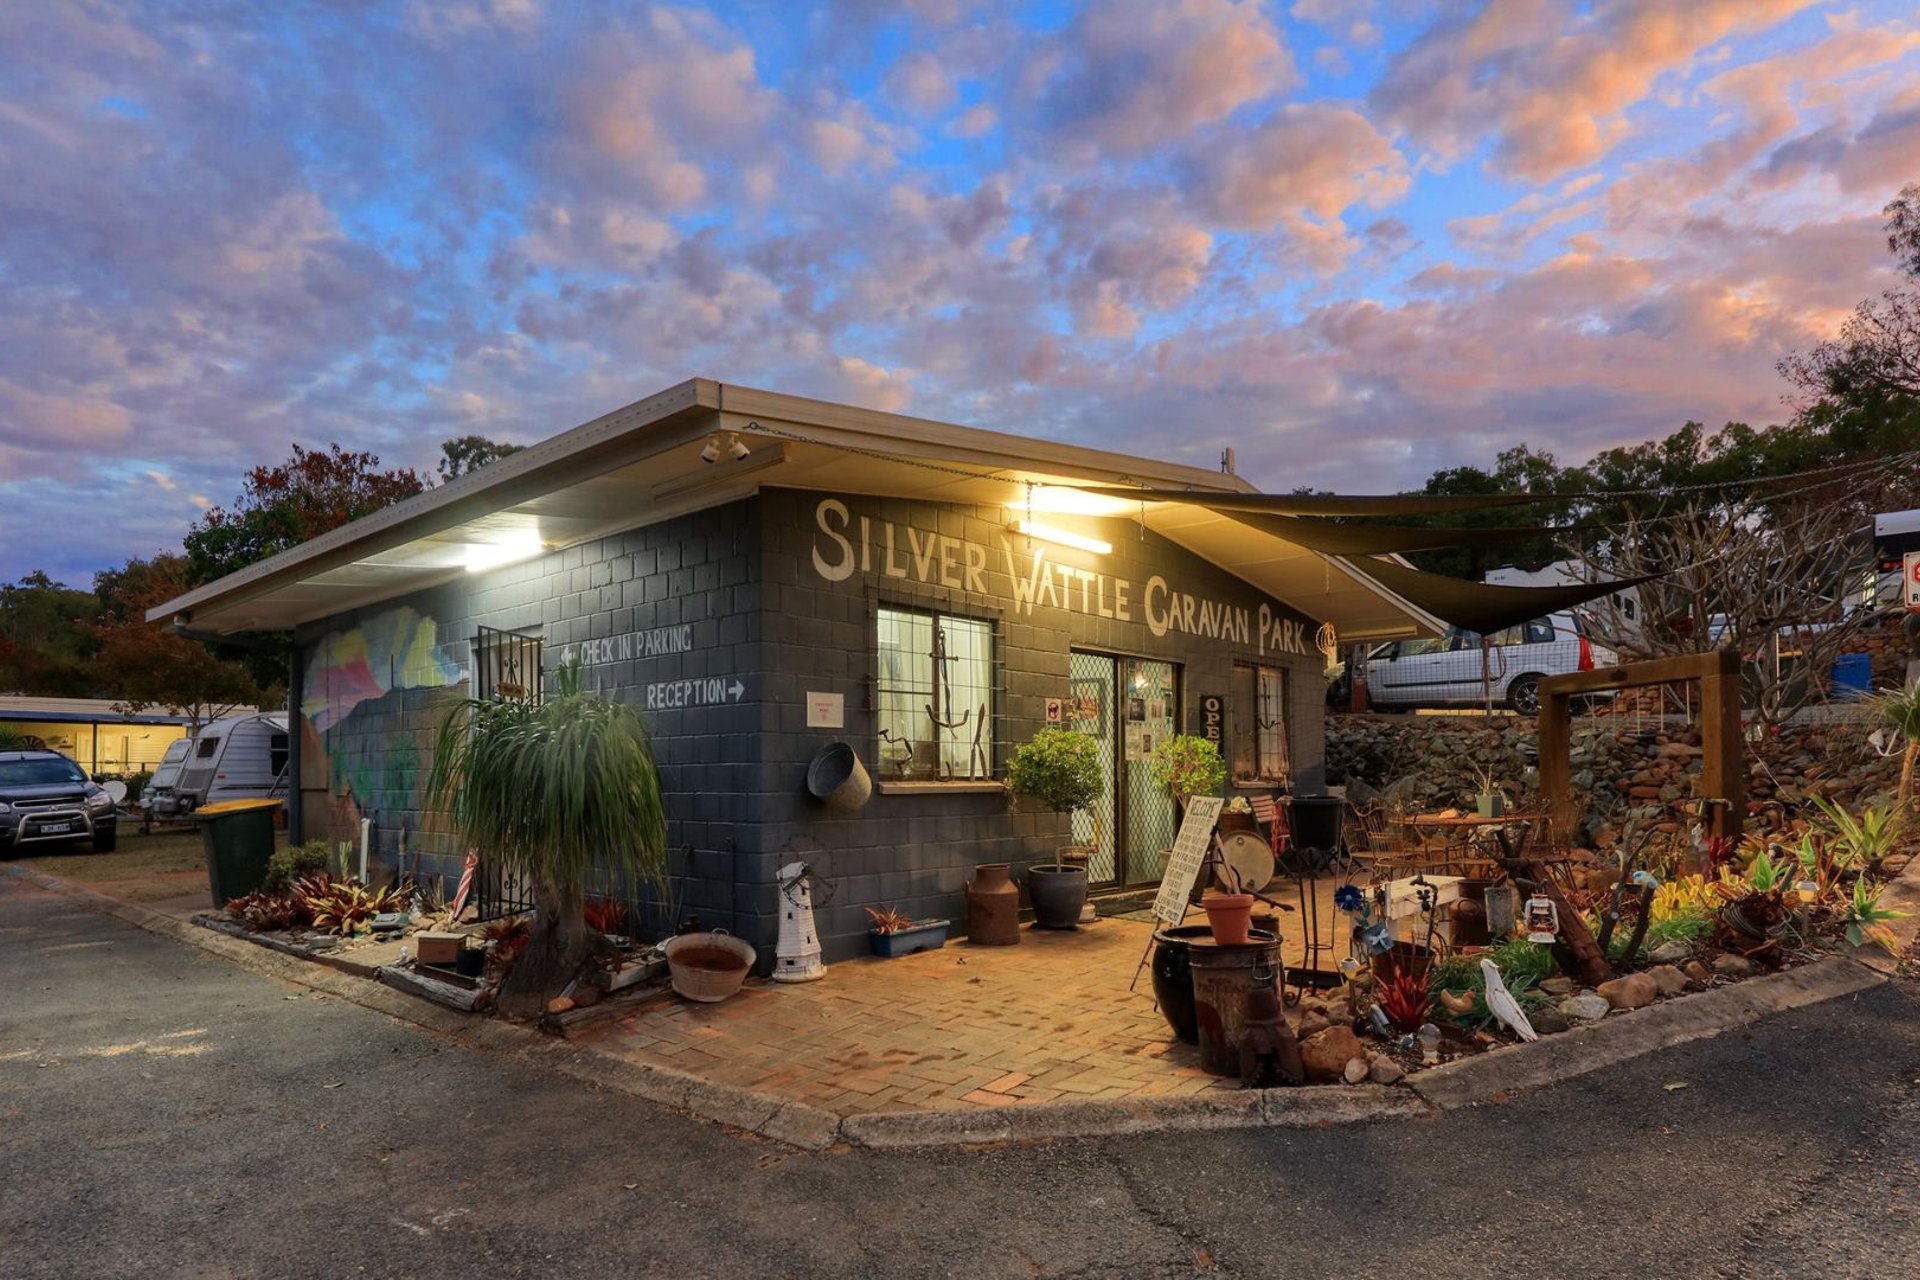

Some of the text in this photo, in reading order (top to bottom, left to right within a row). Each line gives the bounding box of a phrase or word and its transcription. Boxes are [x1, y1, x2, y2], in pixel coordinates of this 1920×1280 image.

[812, 499, 1307, 656] SILVER WATTLE CARAVAN PARK
[581, 625, 692, 666] CHECK IN PARKING
[647, 678, 727, 709] RECEPTION
[1205, 698, 1220, 742] OPE
